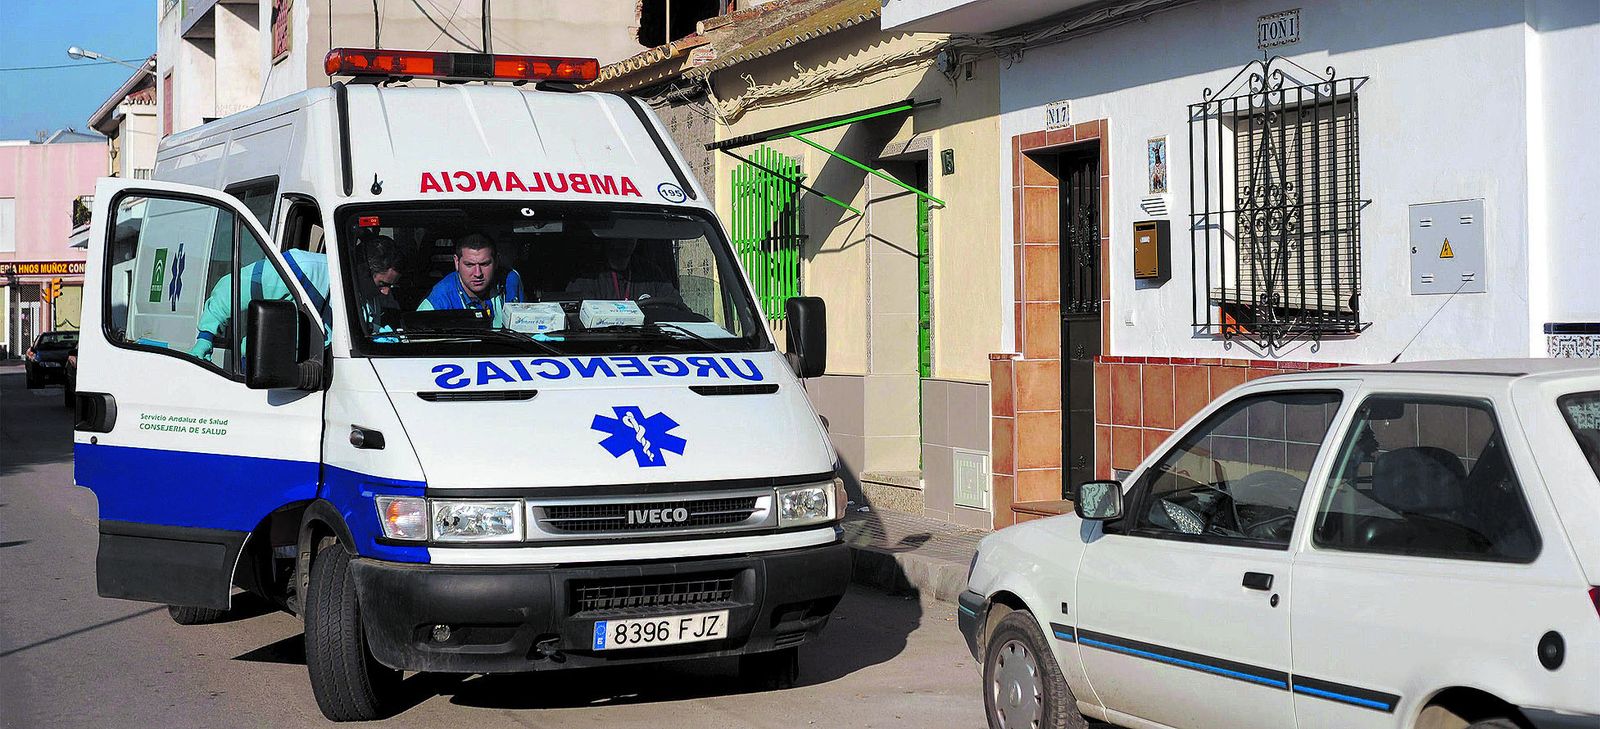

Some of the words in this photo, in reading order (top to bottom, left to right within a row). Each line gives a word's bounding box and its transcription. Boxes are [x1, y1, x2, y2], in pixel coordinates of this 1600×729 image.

[1260, 17, 1295, 42] TOÑI
[661, 189, 683, 198] 195
[18, 263, 39, 274] HNOS
[40, 262, 68, 274] MUÑOZ
[140, 412, 167, 421] Servicio
[168, 415, 197, 424] Andaluz
[209, 418, 229, 426] Salud
[139, 422, 187, 433] CONSEJERIA
[189, 426, 200, 434] DE
[201, 427, 227, 436] SALUD
[627, 507, 688, 525] IVECO
[614, 620, 670, 645] 8396
[678, 615, 720, 640] FJZ
